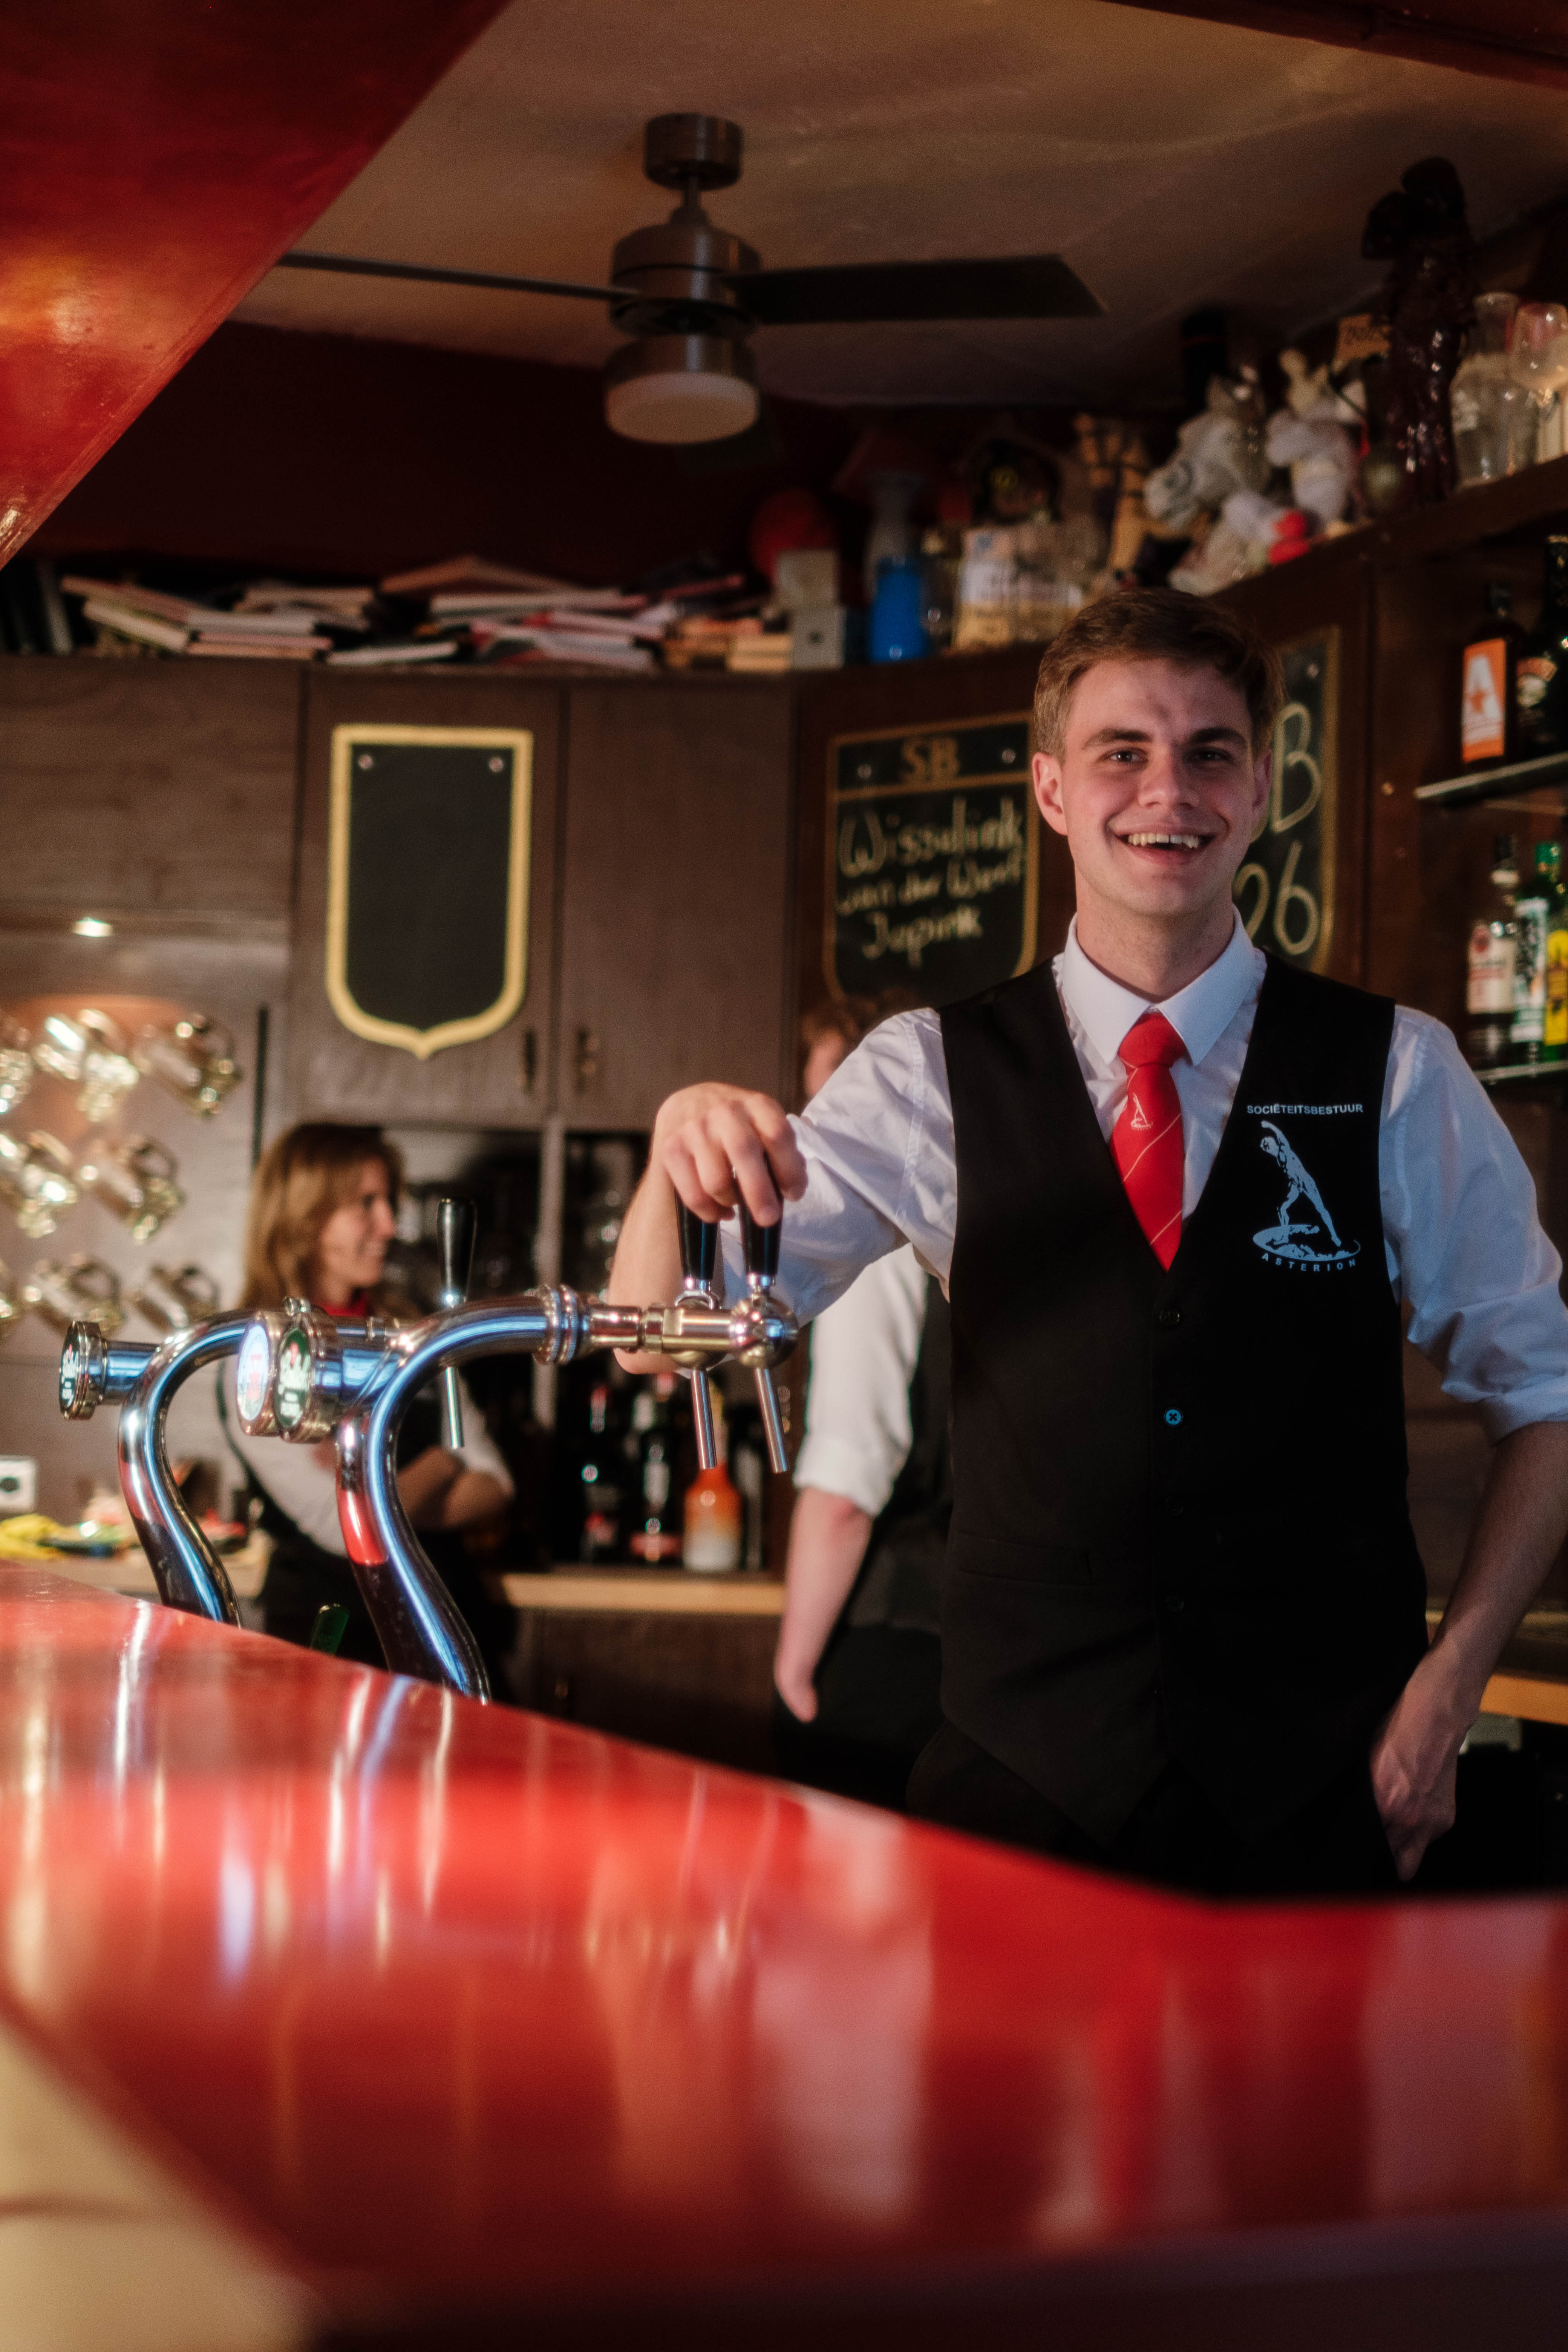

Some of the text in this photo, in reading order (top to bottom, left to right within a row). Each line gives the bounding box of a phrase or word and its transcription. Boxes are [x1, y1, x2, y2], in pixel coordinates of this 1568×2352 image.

[903, 737, 959, 783] SB
[1247, 1103, 1363, 1115] SOCIËTEITSBESTUUR
[1262, 1253, 1356, 1272] ASTERION
